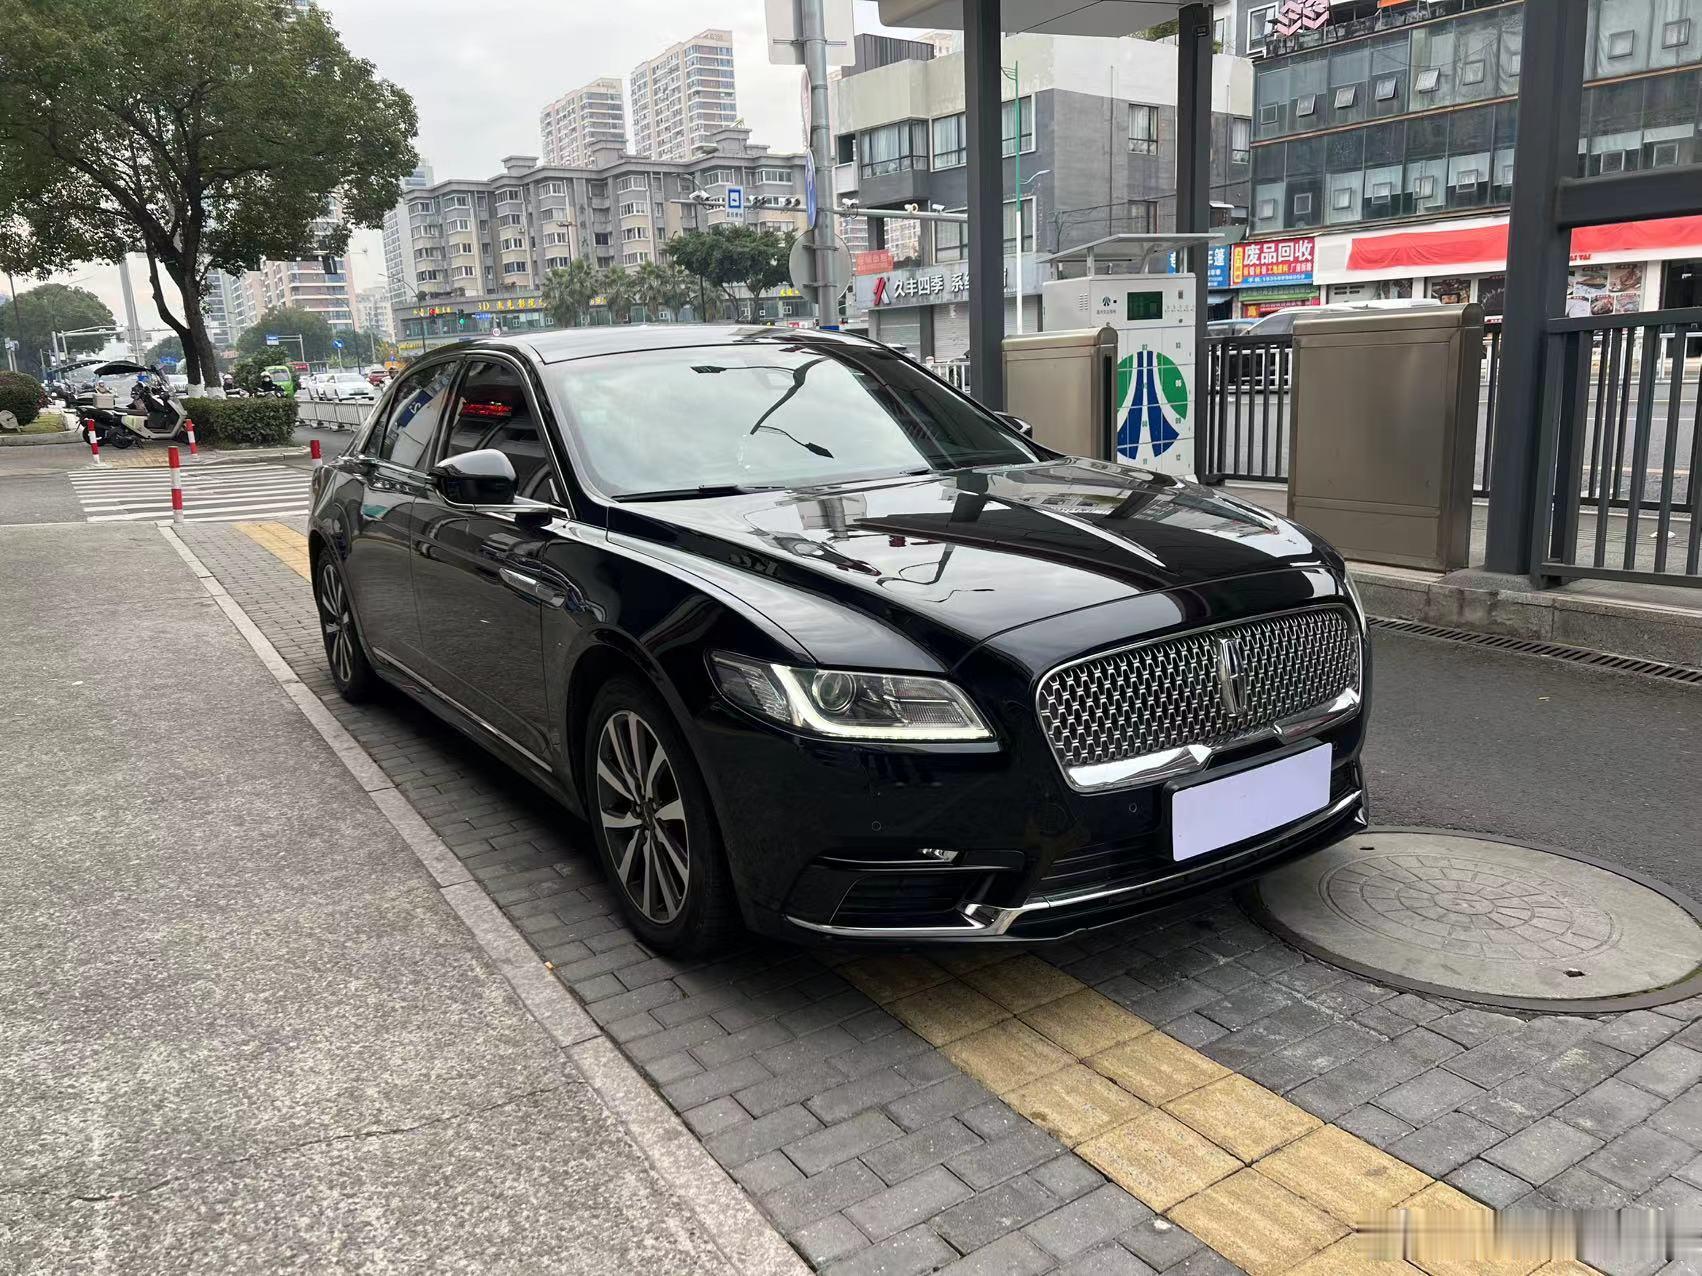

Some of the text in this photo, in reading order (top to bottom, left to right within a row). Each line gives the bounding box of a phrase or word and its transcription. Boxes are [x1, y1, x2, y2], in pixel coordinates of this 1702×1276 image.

[1243, 240, 1313, 265] 废品回收
[894, 273, 944, 298] 久丰四季
